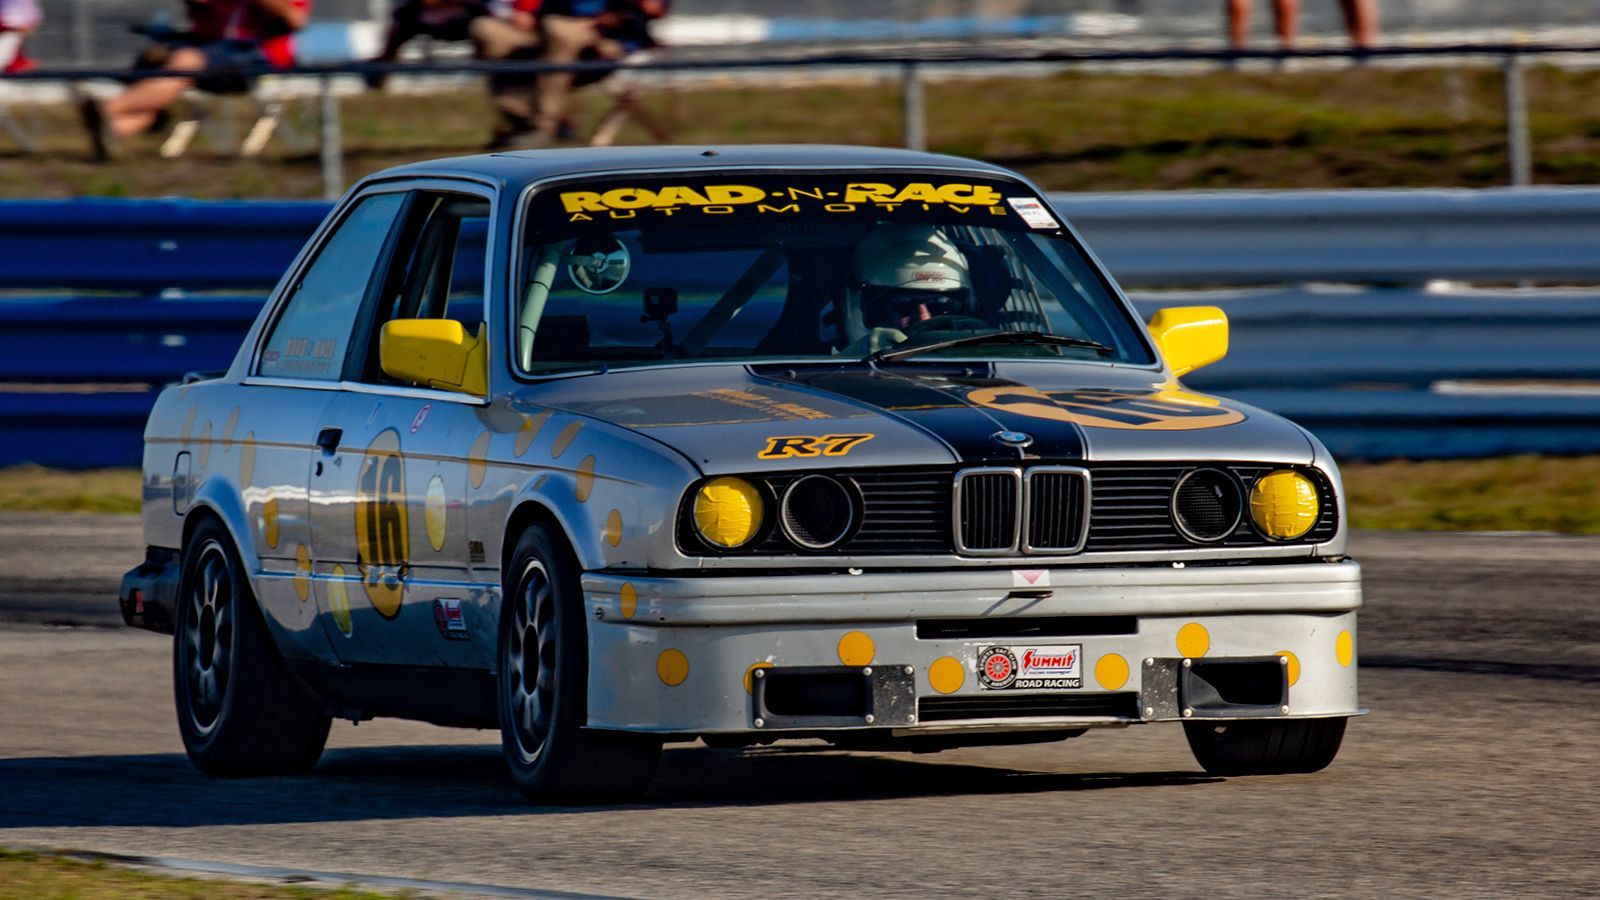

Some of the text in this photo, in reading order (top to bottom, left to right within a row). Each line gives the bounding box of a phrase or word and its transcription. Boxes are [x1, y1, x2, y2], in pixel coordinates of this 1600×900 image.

[559, 184, 767, 213] ROAD
[844, 182, 1002, 205] RACE
[569, 203, 1007, 222] AUTOMOTIVE
[757, 433, 875, 459] R7
[361, 453, 405, 591] 16
[1015, 679, 1080, 688] ROAD RACING
